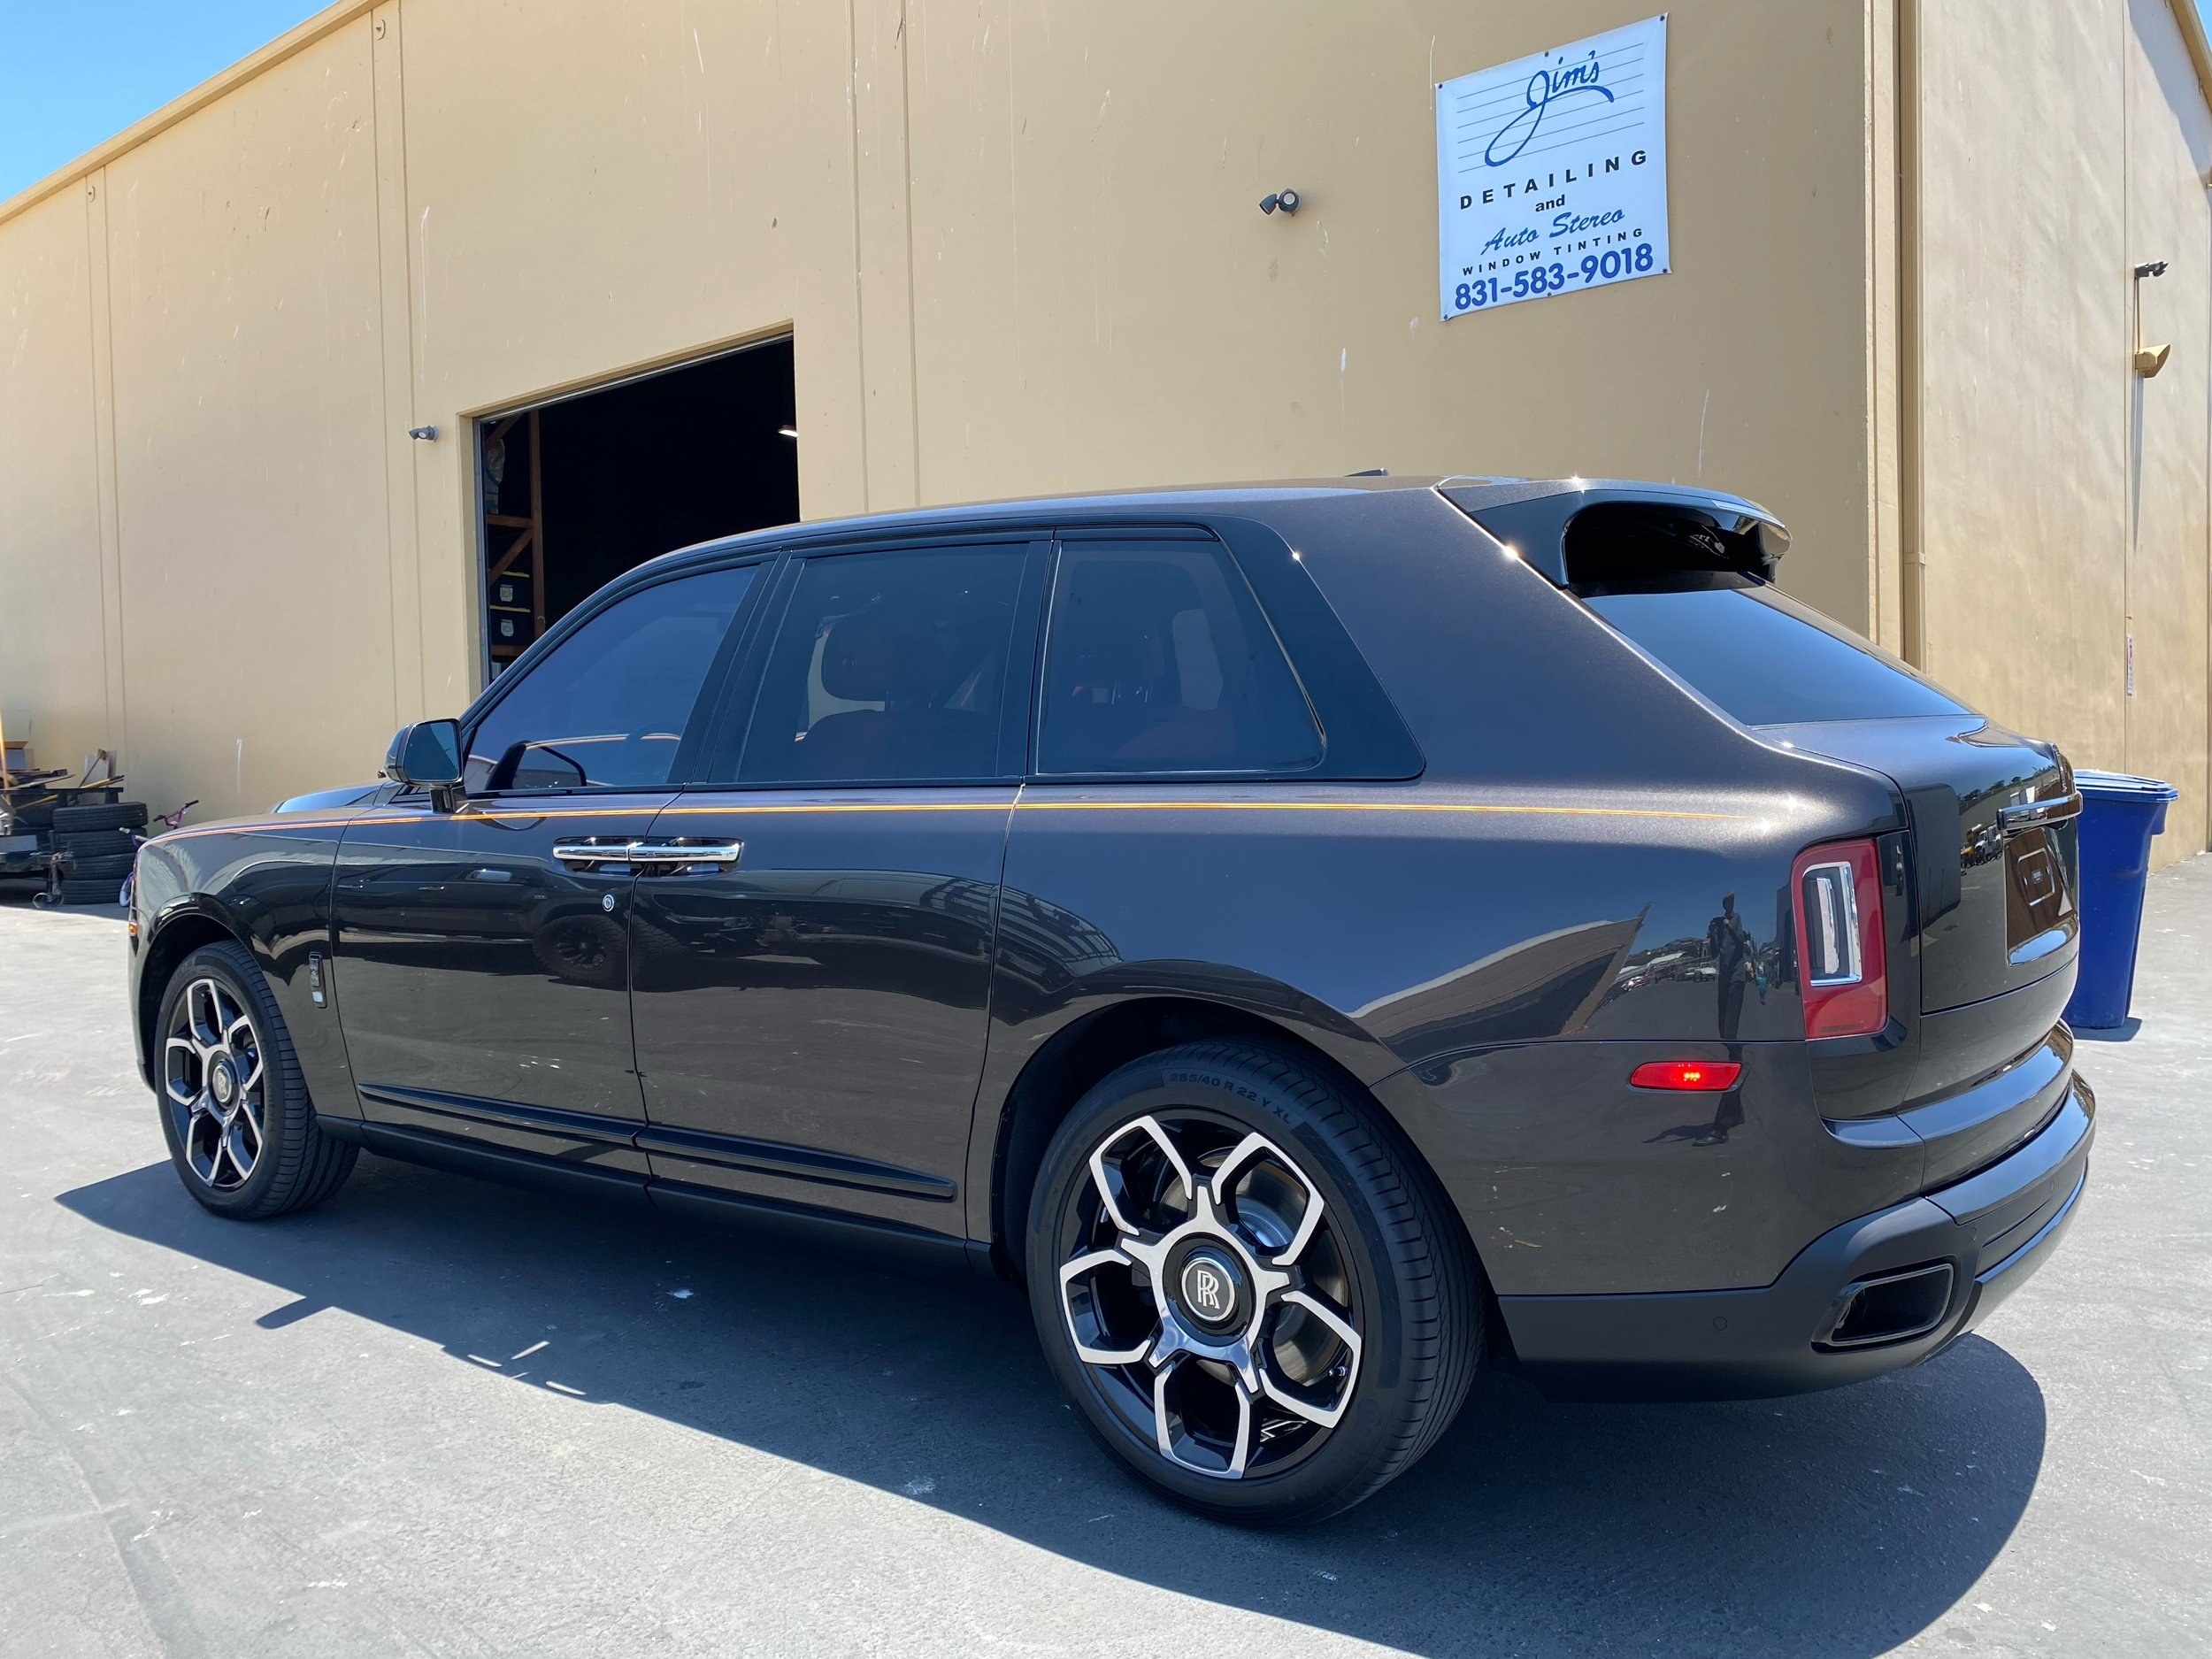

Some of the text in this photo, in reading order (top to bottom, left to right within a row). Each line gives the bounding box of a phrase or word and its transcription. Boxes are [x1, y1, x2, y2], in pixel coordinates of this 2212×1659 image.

[1460, 150, 1647, 210] DETAILING
[1535, 195, 1565, 212] and
[1463, 228, 1643, 276] WINDOW TINTING
[1480, 209, 1625, 256] Auto Stereo
[1455, 242, 1654, 310] 831-583-9018
[1223, 1081, 1234, 1092] R
[1237, 1087, 1258, 1102] 22
[1272, 1106, 1291, 1125] XL
